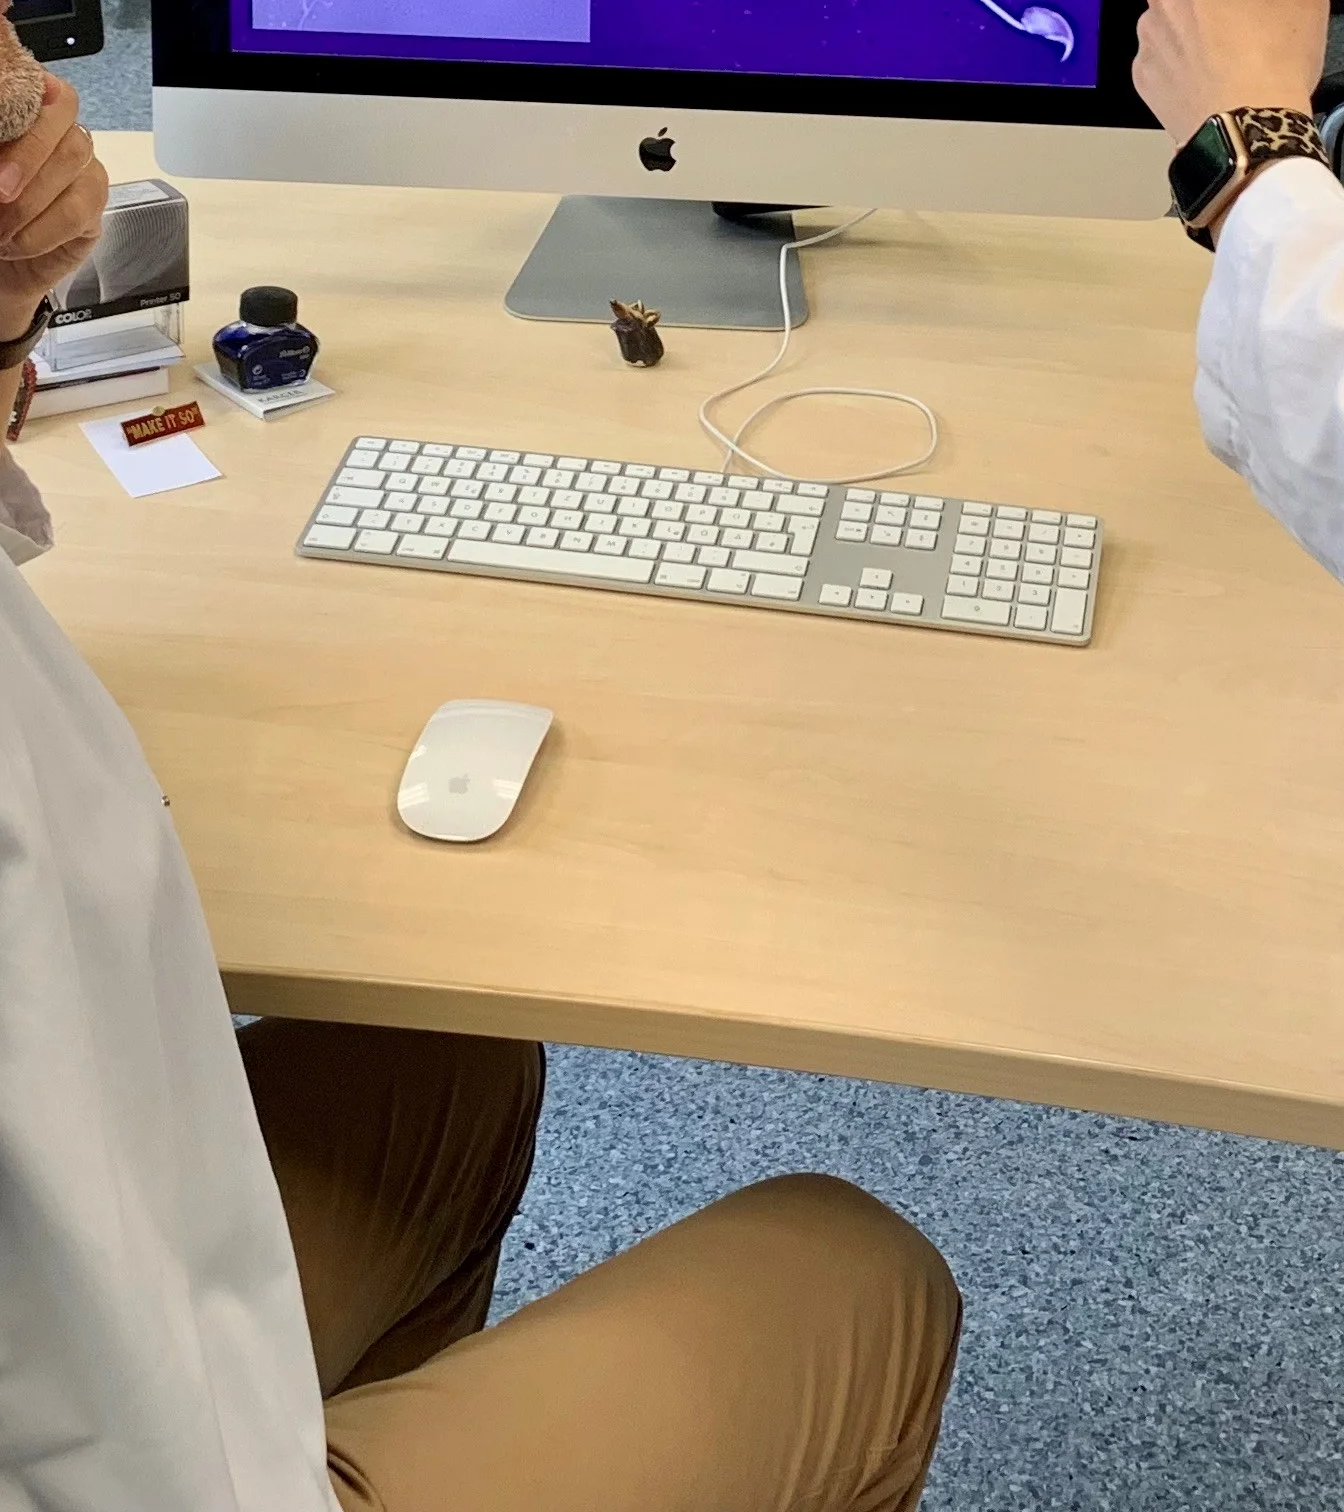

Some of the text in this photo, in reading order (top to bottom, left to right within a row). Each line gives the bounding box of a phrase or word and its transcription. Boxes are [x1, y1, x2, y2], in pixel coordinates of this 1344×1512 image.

[140, 292, 181, 307] Printer 50
[164, 414, 176, 428] IT
